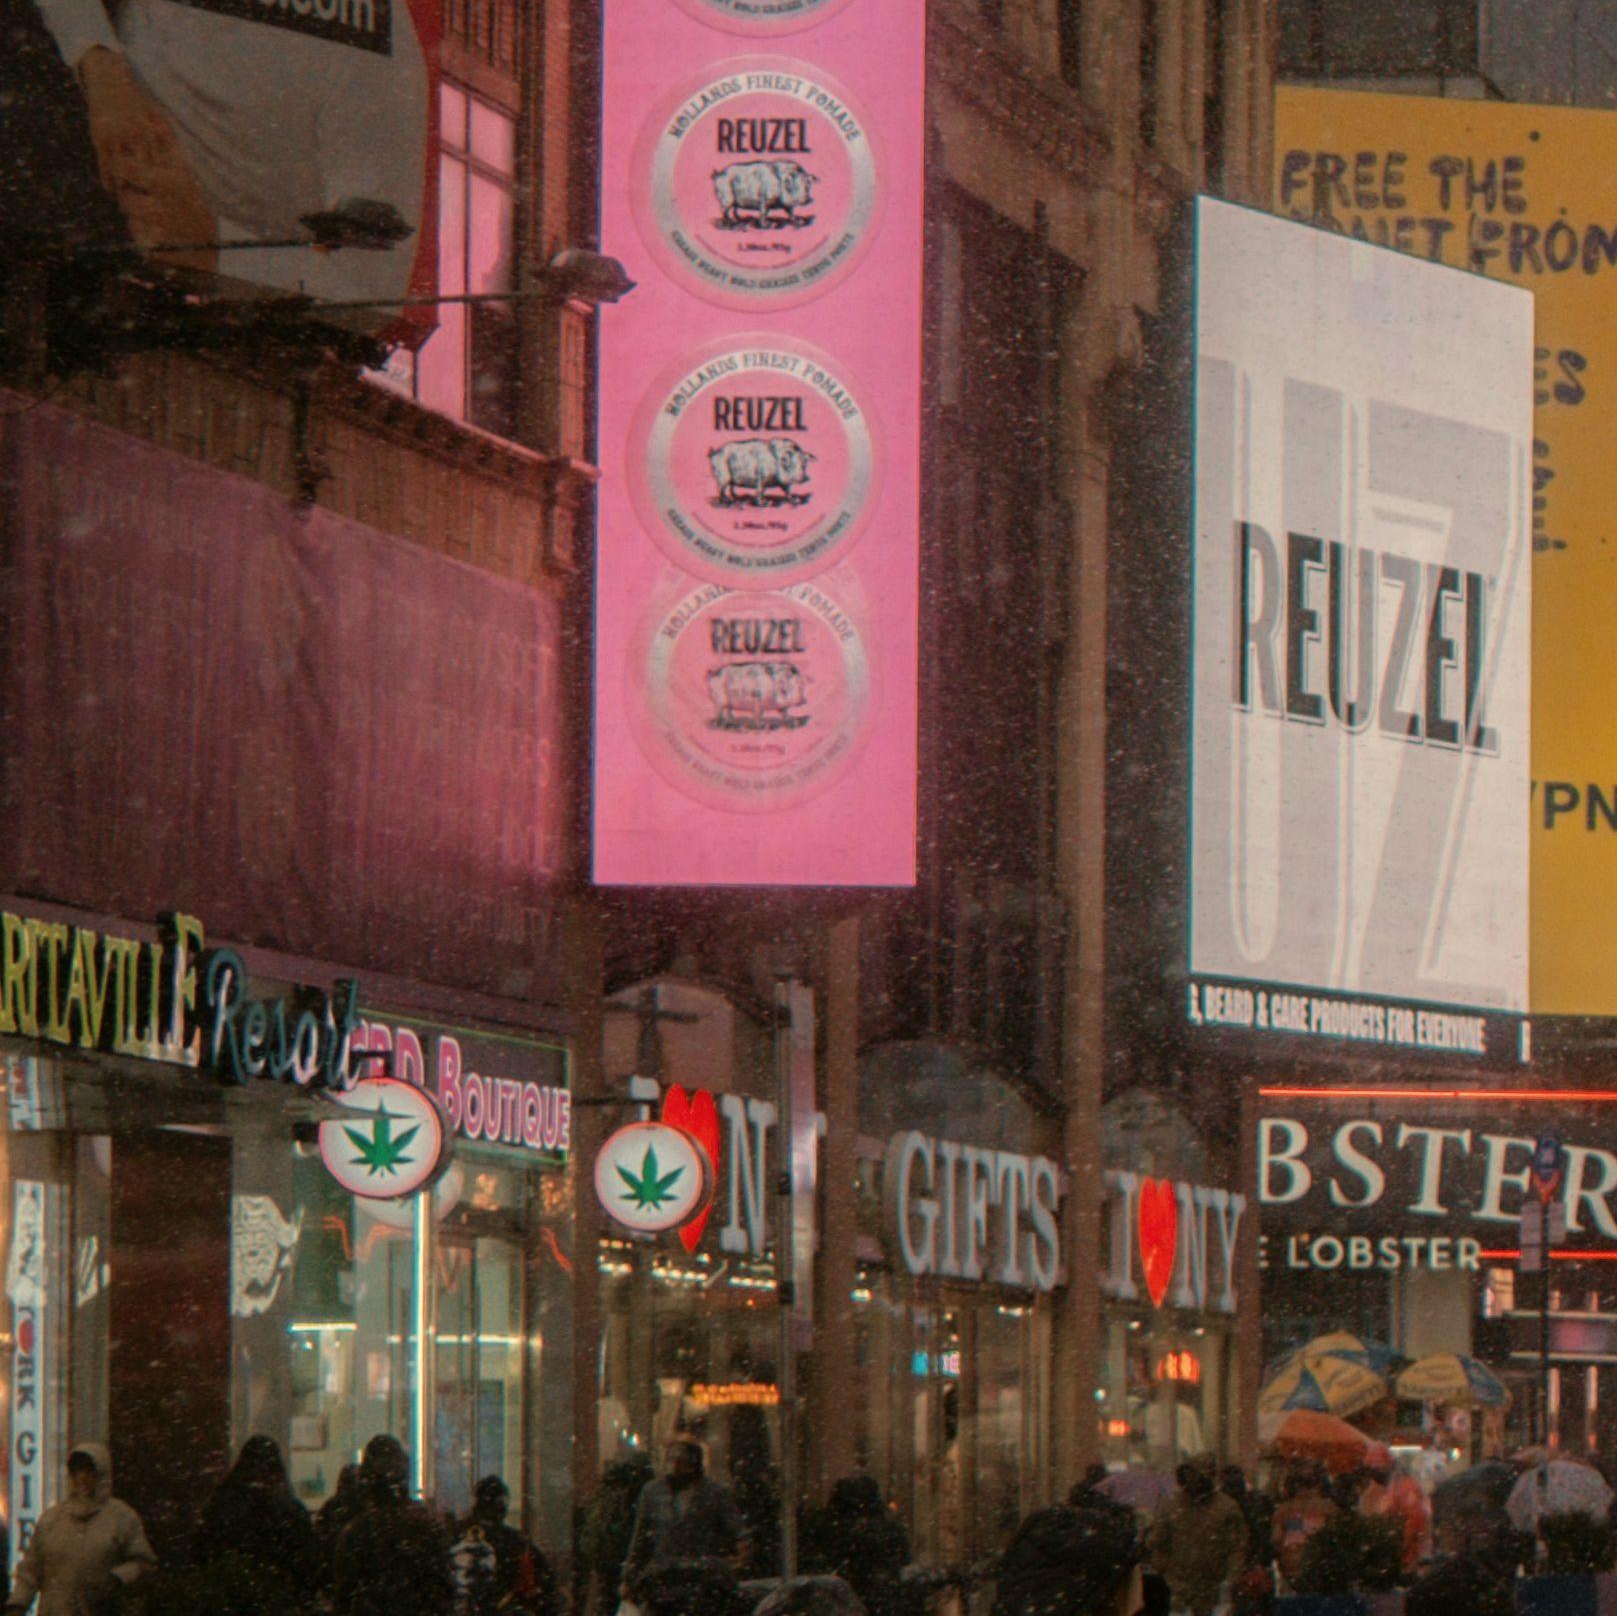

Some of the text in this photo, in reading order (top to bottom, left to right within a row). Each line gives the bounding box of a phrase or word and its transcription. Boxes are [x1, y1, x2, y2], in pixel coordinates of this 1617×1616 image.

[717, 119, 812, 153] REUZEL
[1280, 149, 1527, 214] FREE THE
[714, 397, 809, 431] REUZEL
[1233, 520, 1499, 758] REUZEL
[1310, 998, 1385, 1041] PRODUCTS
[896, 1131, 1060, 1291] GIFTS
[1289, 1236, 1482, 1271] LOBSTER
